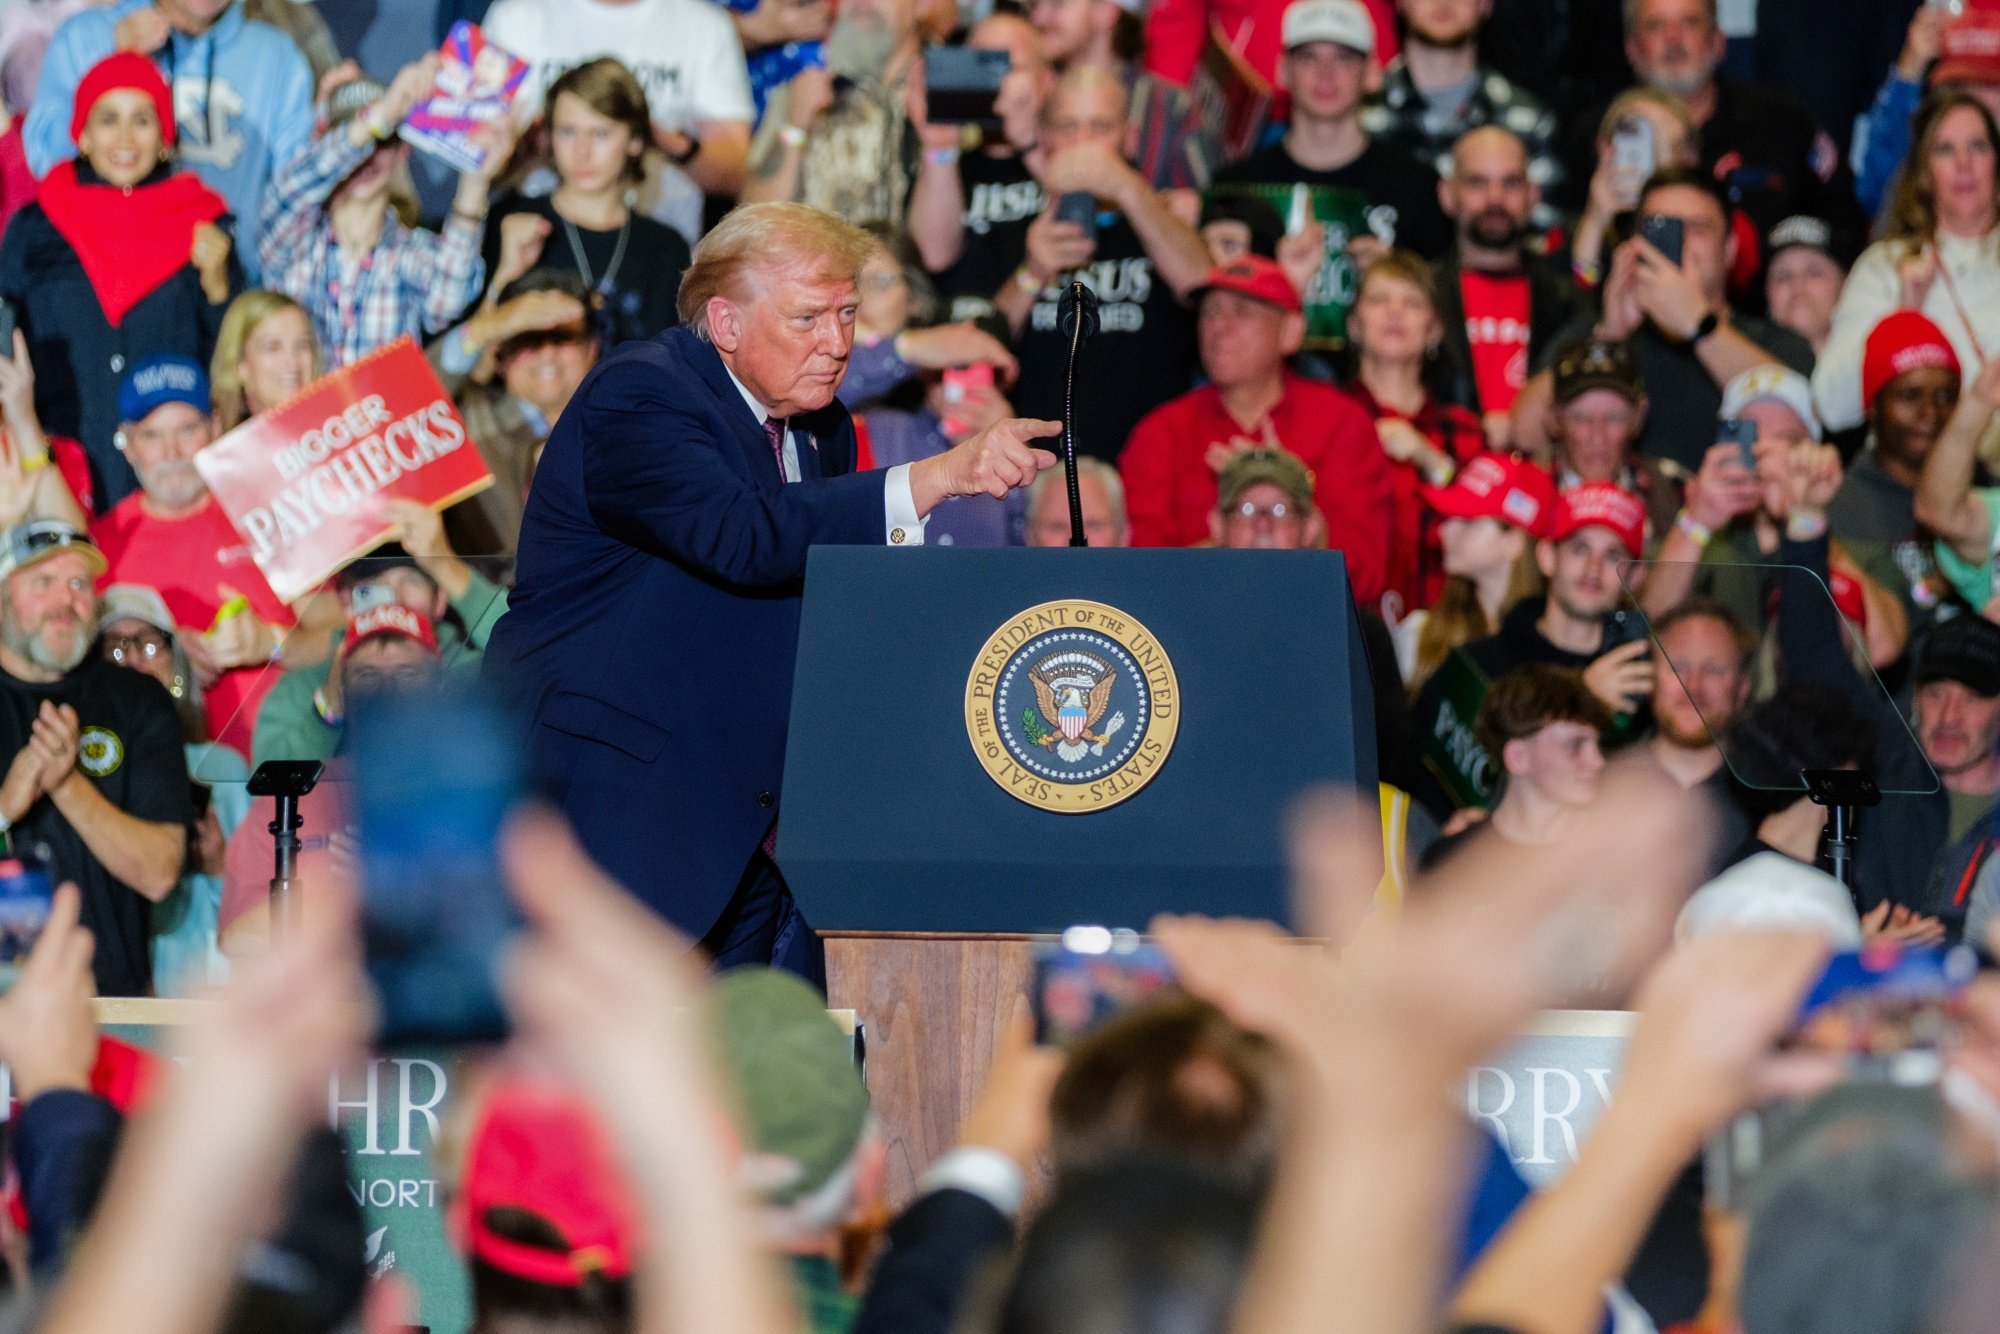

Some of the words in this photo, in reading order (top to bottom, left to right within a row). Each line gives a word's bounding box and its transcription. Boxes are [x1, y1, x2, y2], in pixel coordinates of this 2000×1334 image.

[272, 394, 393, 481] BIGGER
[242, 400, 466, 566] PAYCHECKS
[1075, 610, 1095, 623] OF
[1100, 614, 1125, 635] THE
[973, 608, 1068, 700] PRESIDENT
[1129, 633, 1172, 719] UNITED
[975, 708, 991, 737] THE
[983, 740, 1000, 759] OF
[1435, 698, 1490, 797] PAYC
[999, 757, 1052, 801] SEAL
[1090, 739, 1162, 802] STATES
[327, 1058, 448, 1155] HR
[346, 1179, 442, 1208] NORT
